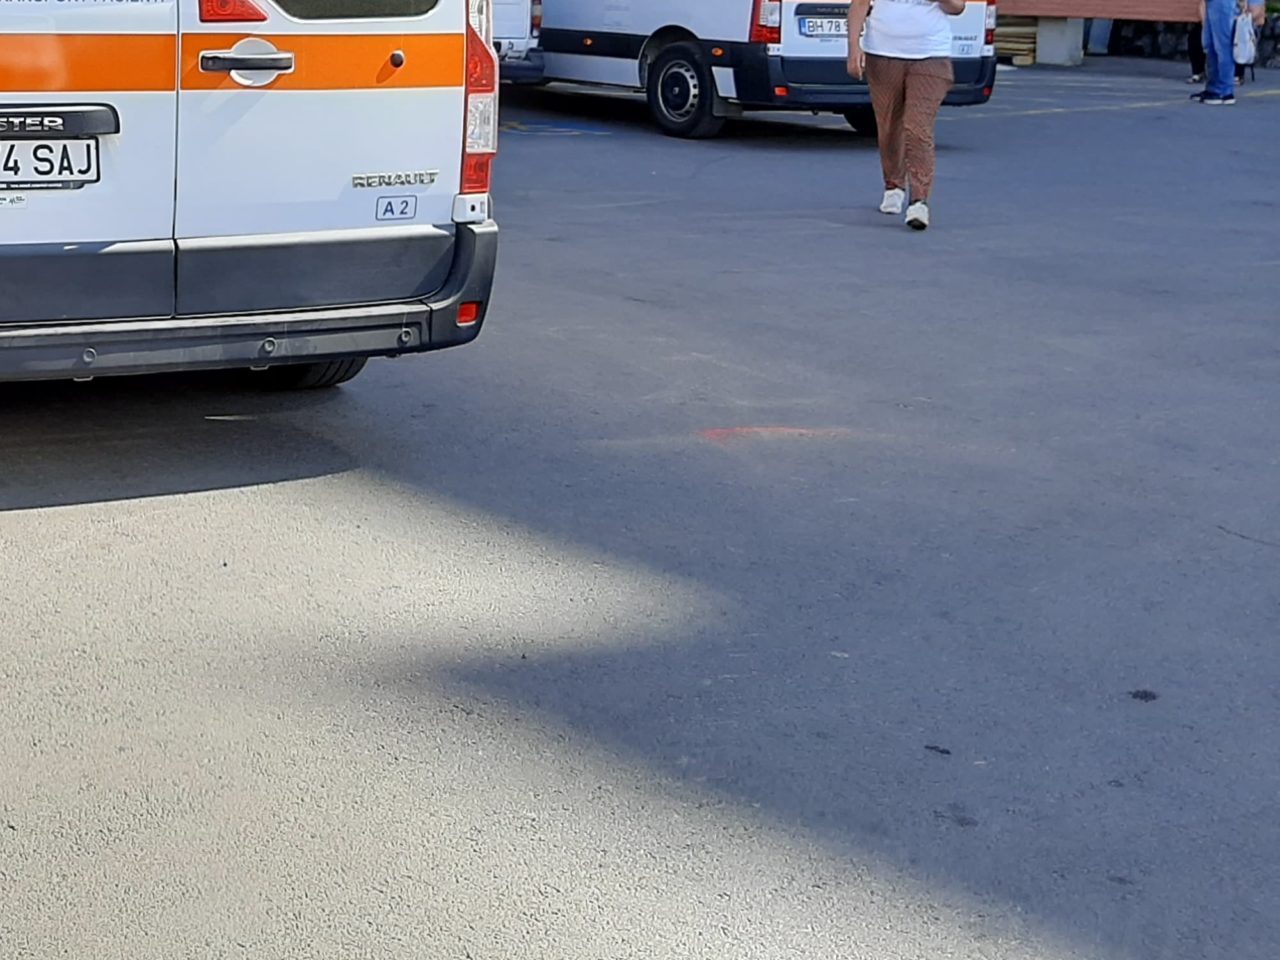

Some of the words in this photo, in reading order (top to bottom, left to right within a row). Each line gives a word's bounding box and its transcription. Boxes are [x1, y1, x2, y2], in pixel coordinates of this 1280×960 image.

[807, 20, 824, 33] BH
[32, 142, 92, 177] SAJ
[352, 170, 440, 189] RENAULT
[382, 200, 395, 217] A
[399, 199, 409, 216] 2
